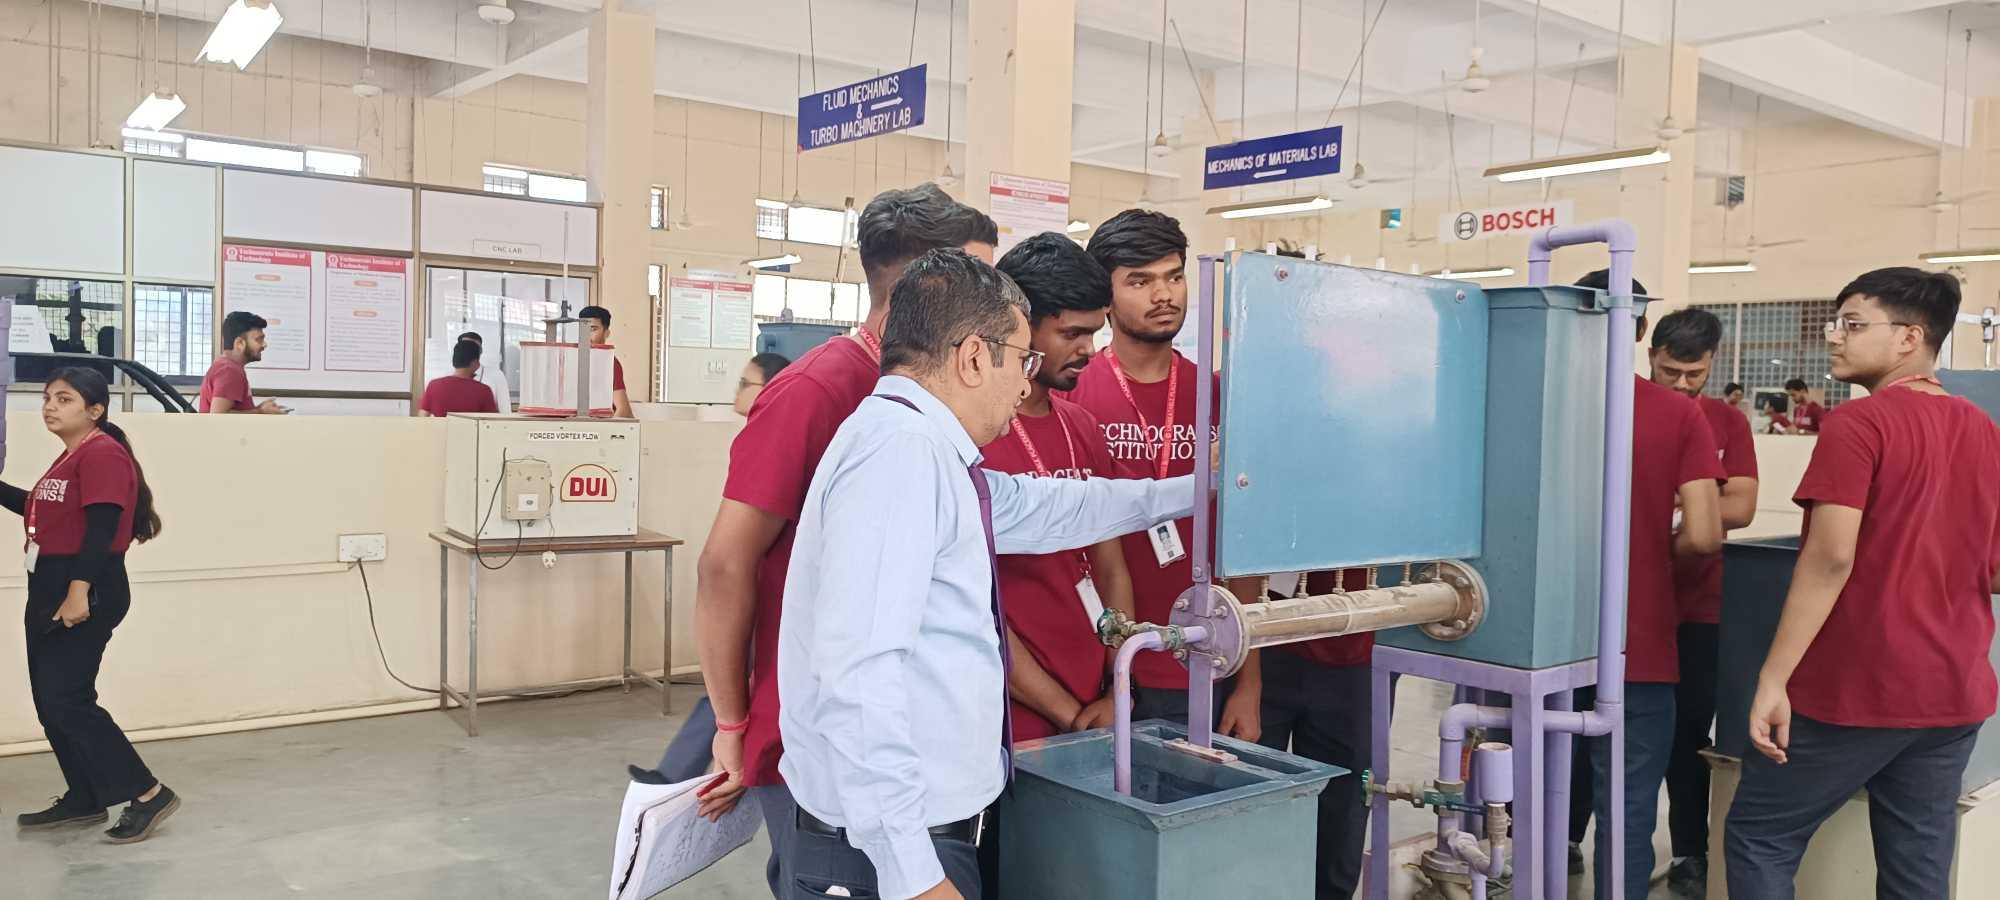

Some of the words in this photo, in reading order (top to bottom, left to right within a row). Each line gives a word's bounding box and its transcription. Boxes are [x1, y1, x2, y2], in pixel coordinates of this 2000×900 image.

[823, 90, 847, 112] FLUID
[850, 75, 900, 105] MECHANICS
[856, 103, 863, 120] &
[811, 125, 839, 146] TURBO
[841, 112, 889, 139] MACHINERY
[892, 107, 911, 128] LAB
[1207, 155, 1254, 174] MECHANICS
[1255, 152, 1267, 168] OF
[1268, 145, 1318, 166] MATERIALS
[1319, 142, 1338, 159] LAB
[1482, 207, 1555, 232] BOSCH
[569, 477, 608, 496] DUI
